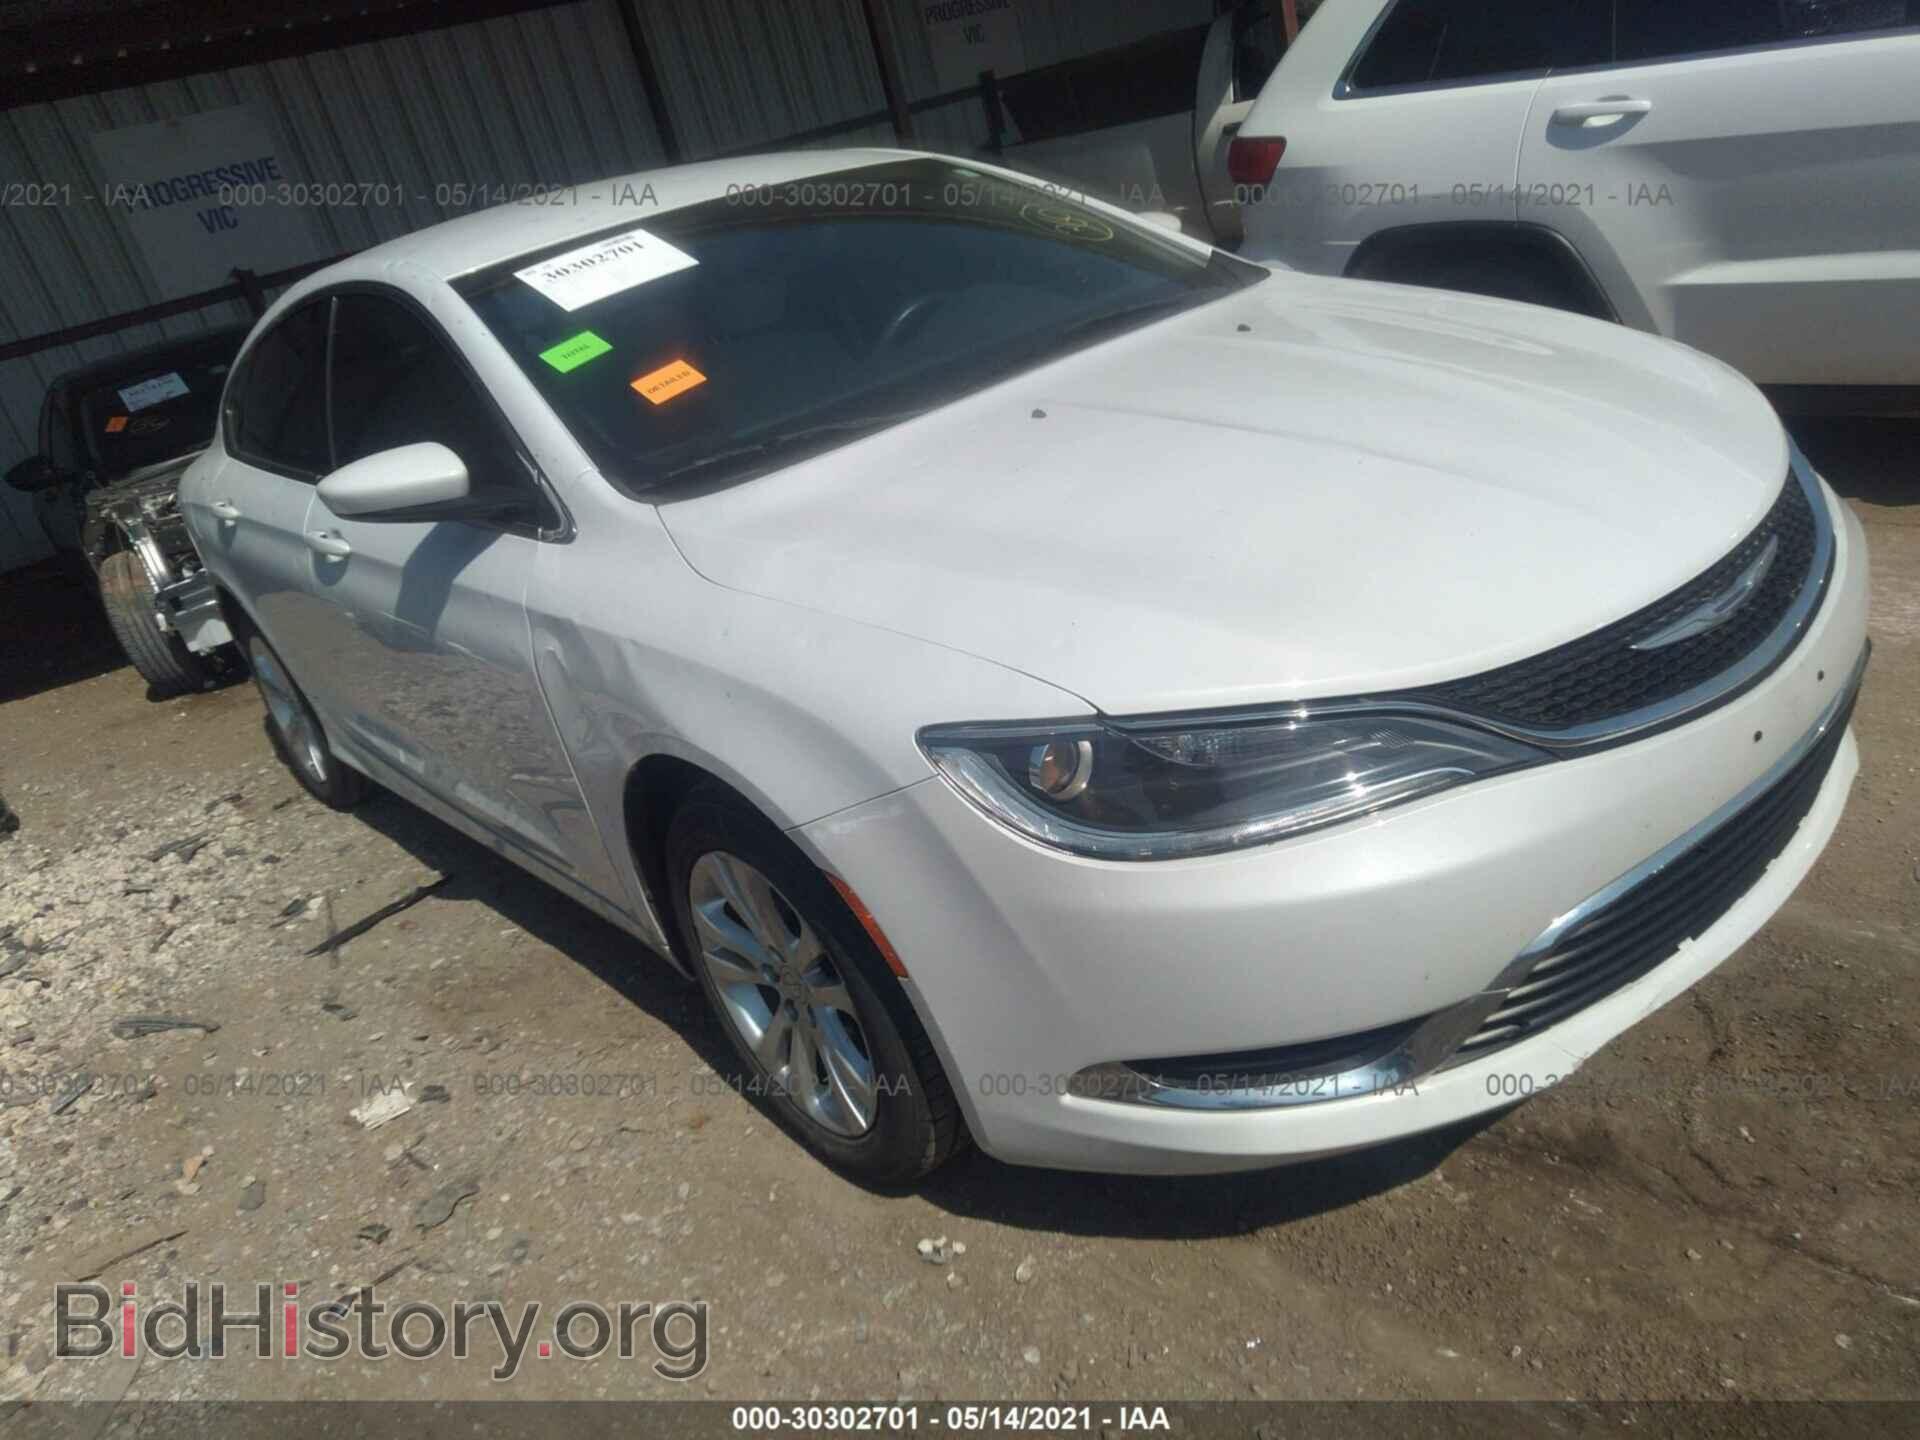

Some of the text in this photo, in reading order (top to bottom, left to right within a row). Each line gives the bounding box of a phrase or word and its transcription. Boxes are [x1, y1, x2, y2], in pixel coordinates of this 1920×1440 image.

[124, 156, 283, 213] PROGRESSIVE
[197, 206, 240, 234] VIC
[542, 240, 645, 283] 30302701
